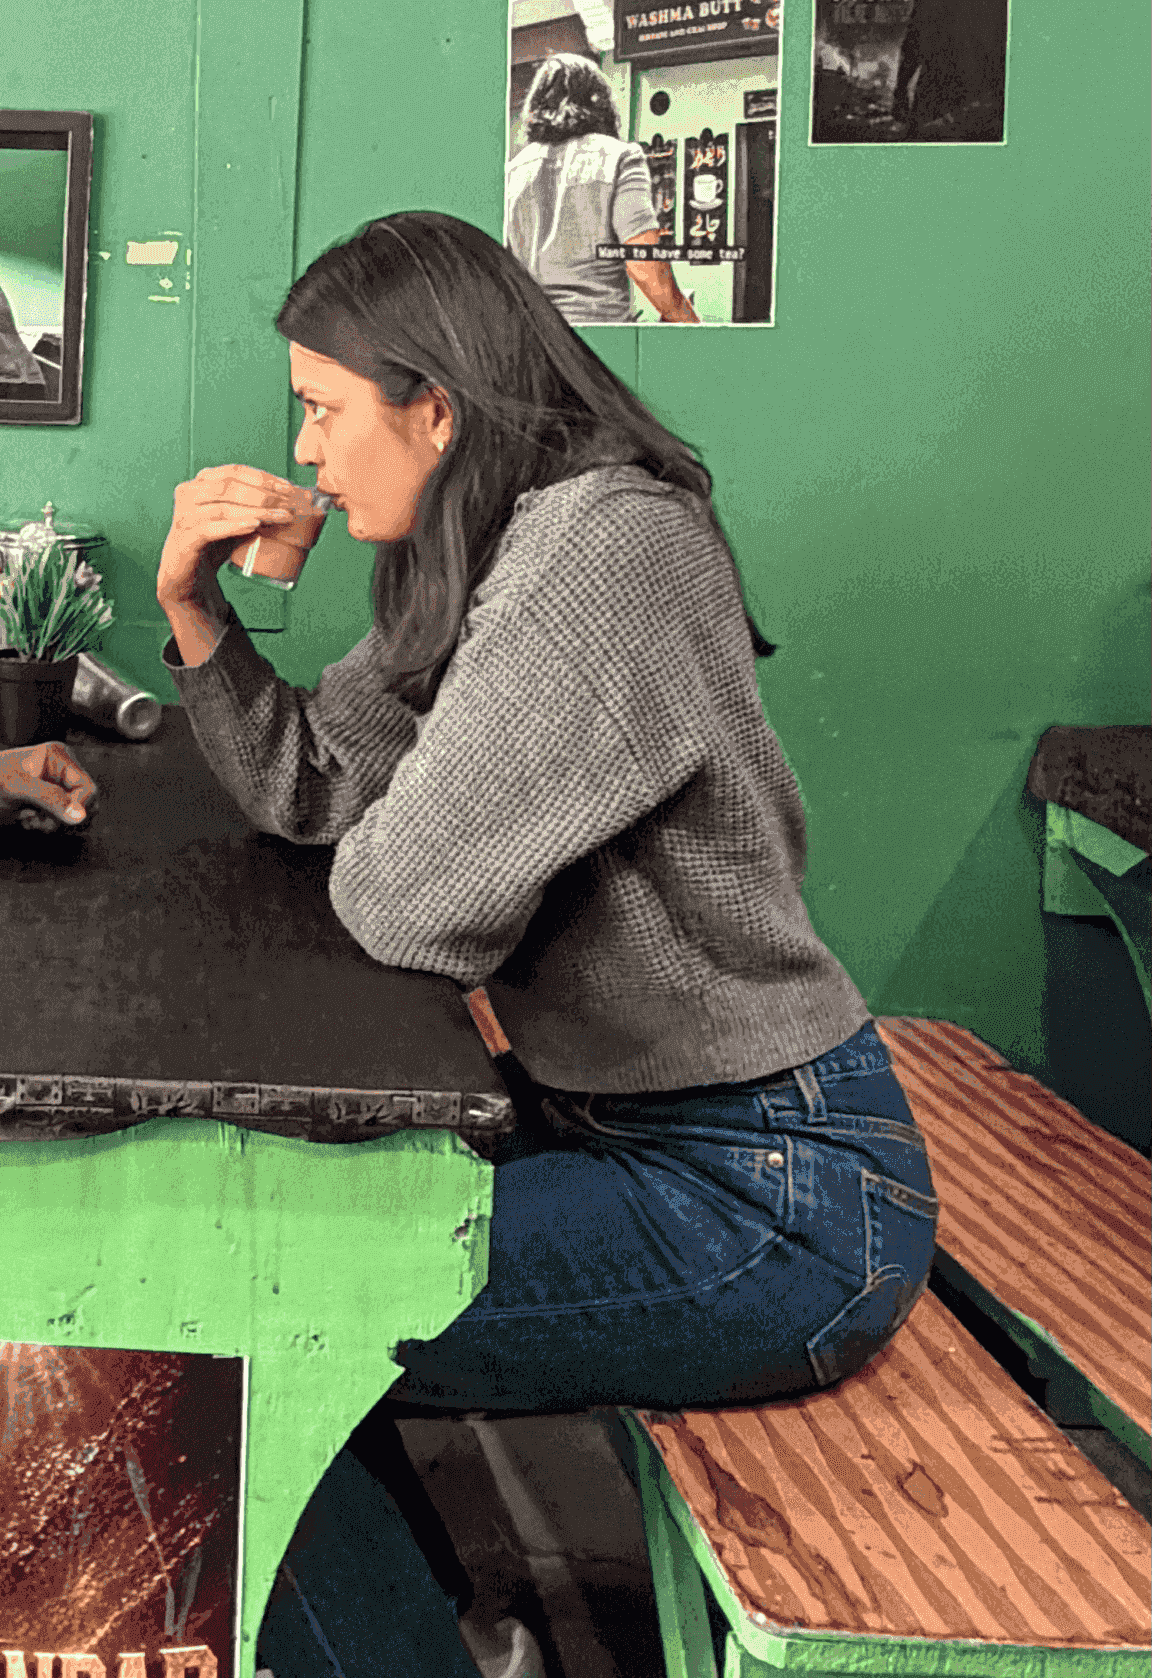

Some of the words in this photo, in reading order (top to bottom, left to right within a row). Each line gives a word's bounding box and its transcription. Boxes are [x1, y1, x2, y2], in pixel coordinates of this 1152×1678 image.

[626, 5, 694, 29] WASHMA
[598, 247, 626, 259] Want
[633, 247, 647, 259] to
[652, 247, 681, 259] have
[687, 249, 714, 259] some
[719, 247, 745, 260] tea?
